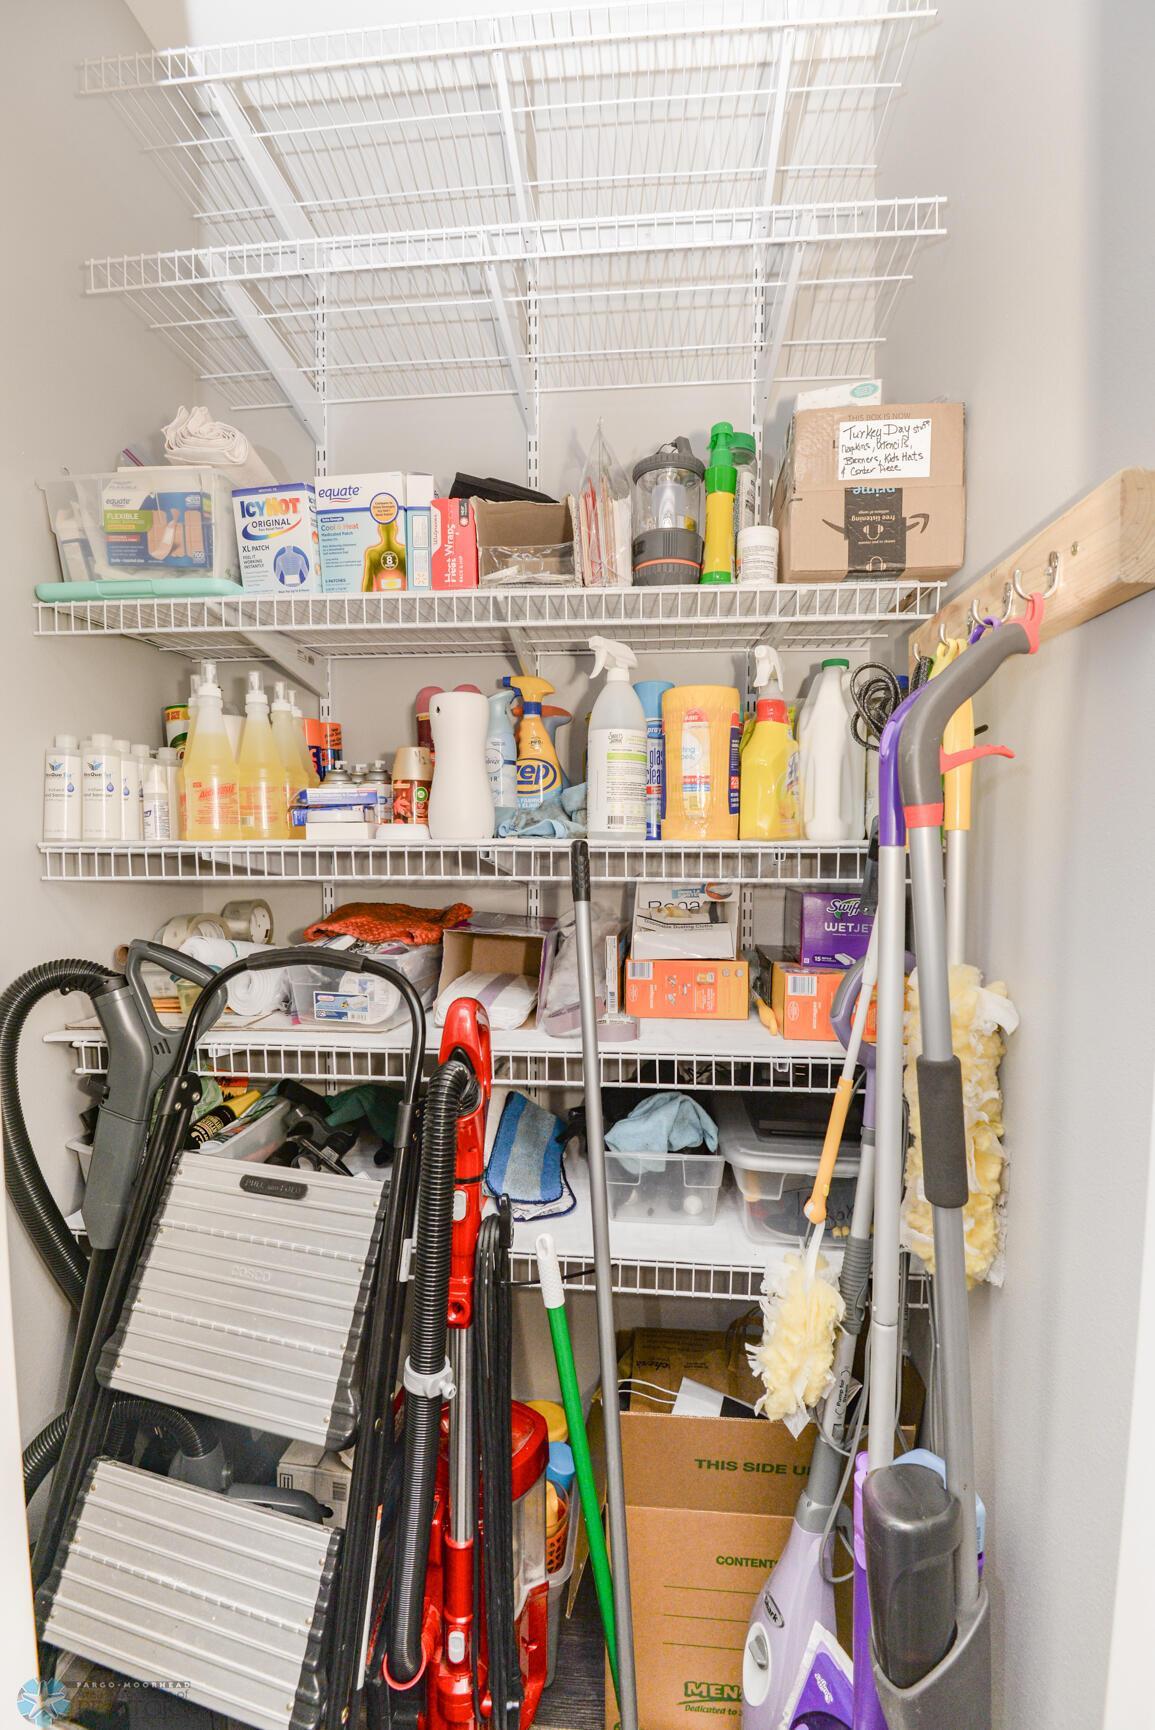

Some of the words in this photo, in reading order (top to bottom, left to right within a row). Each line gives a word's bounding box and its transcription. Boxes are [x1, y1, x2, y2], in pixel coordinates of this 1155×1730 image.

[842, 424, 882, 440] Turkey
[883, 423, 911, 438] Day
[105, 497, 131, 505] equate
[318, 485, 360, 501] equate
[251, 518, 291, 529] ORIGINAL
[444, 523, 459, 556] Wraps
[251, 544, 270, 552] PATCH
[385, 555, 394, 565] 8
[444, 557, 457, 583] Heat
[827, 899, 861, 916] Swiff
[825, 921, 873, 933] WETJE
[694, 1458, 738, 1471] THIS
[743, 1462, 787, 1474] SIDE
[793, 1465, 810, 1476] U
[684, 1681, 742, 1698] MEN
[684, 1704, 726, 1714] Dedicated
[728, 1708, 738, 1716] to
